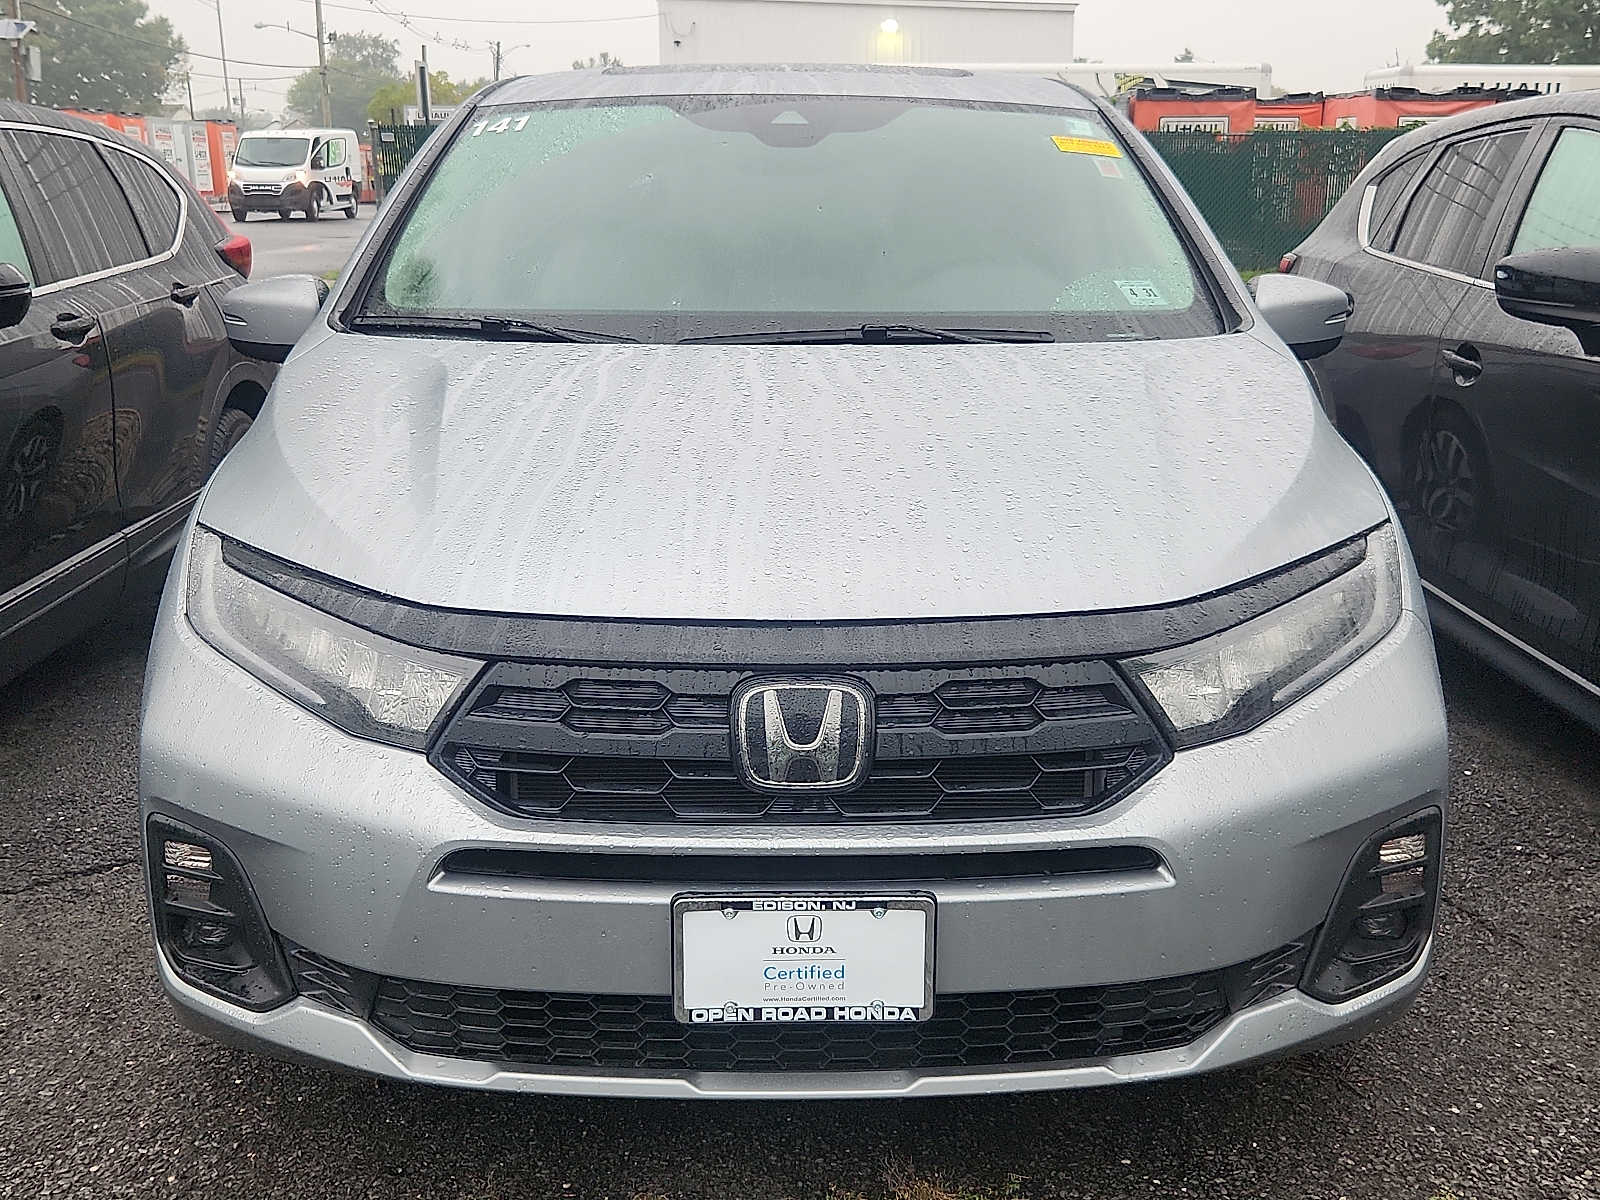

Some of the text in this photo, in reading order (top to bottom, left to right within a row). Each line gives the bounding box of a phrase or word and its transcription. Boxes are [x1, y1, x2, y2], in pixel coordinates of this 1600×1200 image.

[472, 114, 531, 138] 141
[832, 901, 856, 911] NJ
[771, 946, 837, 955] HONDA
[763, 964, 845, 980] Certified
[764, 982, 845, 991] Pre-Owned
[691, 1006, 917, 1022] OPEN ROAD HONDA
